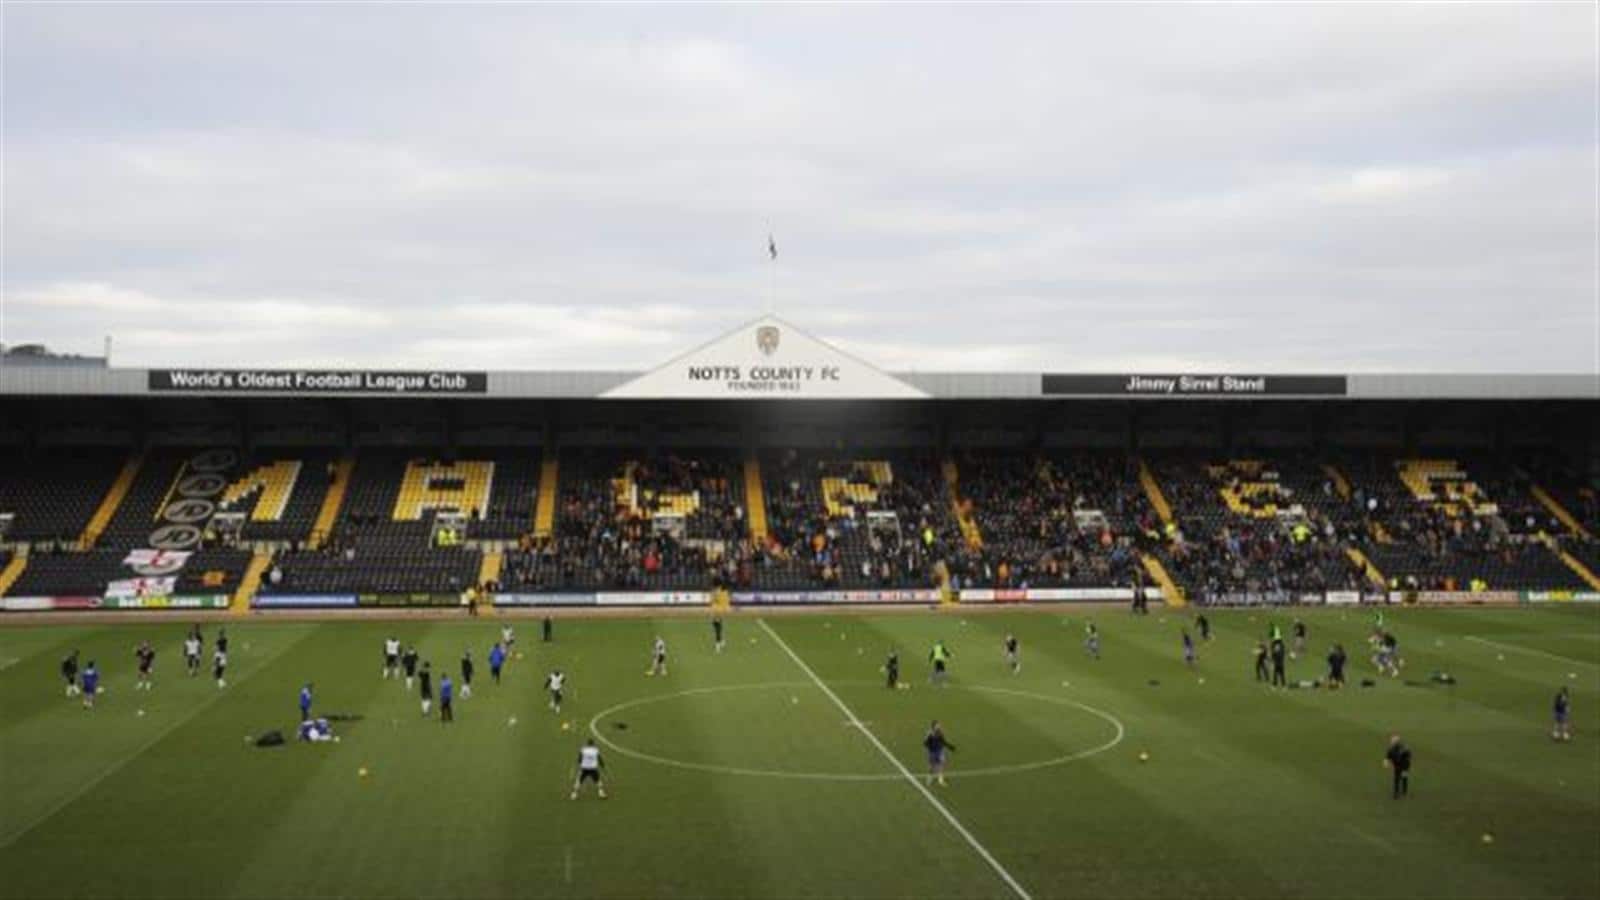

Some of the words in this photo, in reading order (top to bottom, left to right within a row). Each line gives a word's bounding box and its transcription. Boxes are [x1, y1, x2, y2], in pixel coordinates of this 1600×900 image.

[170, 372, 233, 387] World's
[238, 373, 291, 388] Oldest
[295, 373, 361, 389] Football
[365, 374, 425, 392] League
[429, 374, 467, 389] Club
[688, 367, 741, 380] NOTTS
[749, 367, 813, 380] COUNTY
[821, 367, 840, 380] FC
[1126, 376, 1175, 393] Jimmy
[1222, 376, 1265, 391] Stand
